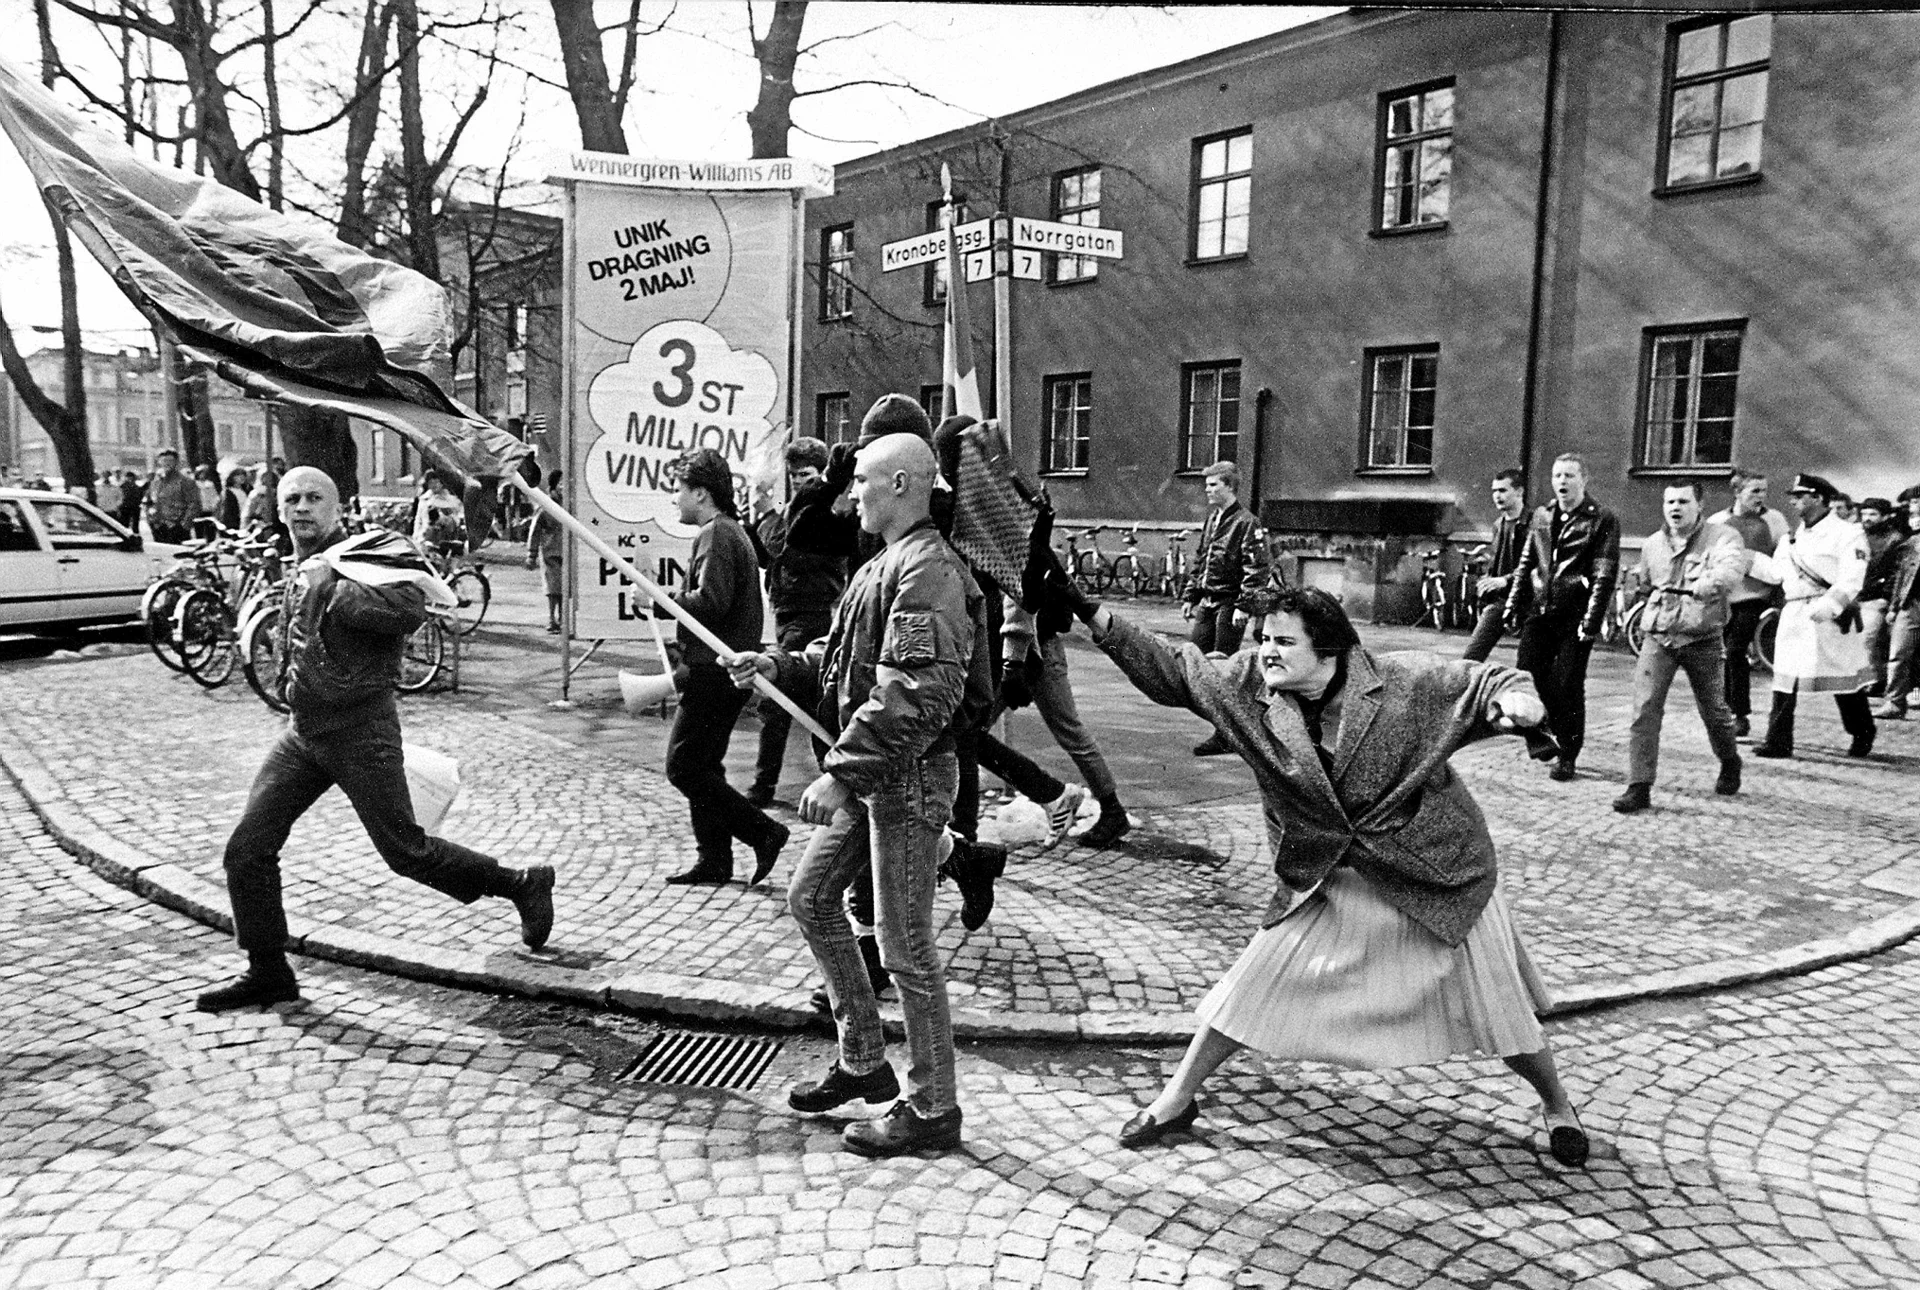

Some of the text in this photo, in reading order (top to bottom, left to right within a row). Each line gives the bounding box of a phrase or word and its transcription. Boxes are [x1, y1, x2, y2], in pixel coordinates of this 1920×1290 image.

[570, 154, 762, 182] Wennergren-Williams
[767, 163, 793, 181] AB
[614, 219, 671, 249] UNIK
[886, 230, 986, 265] Kronobegsg.
[1020, 224, 1115, 252] Norrgatan
[587, 234, 711, 281] DRAGNING
[974, 258, 983, 277] 7
[1022, 256, 1032, 274] 7
[620, 265, 696, 301] 2 MAJ!
[652, 338, 744, 416] 3 ST
[626, 411, 749, 462] MILJON
